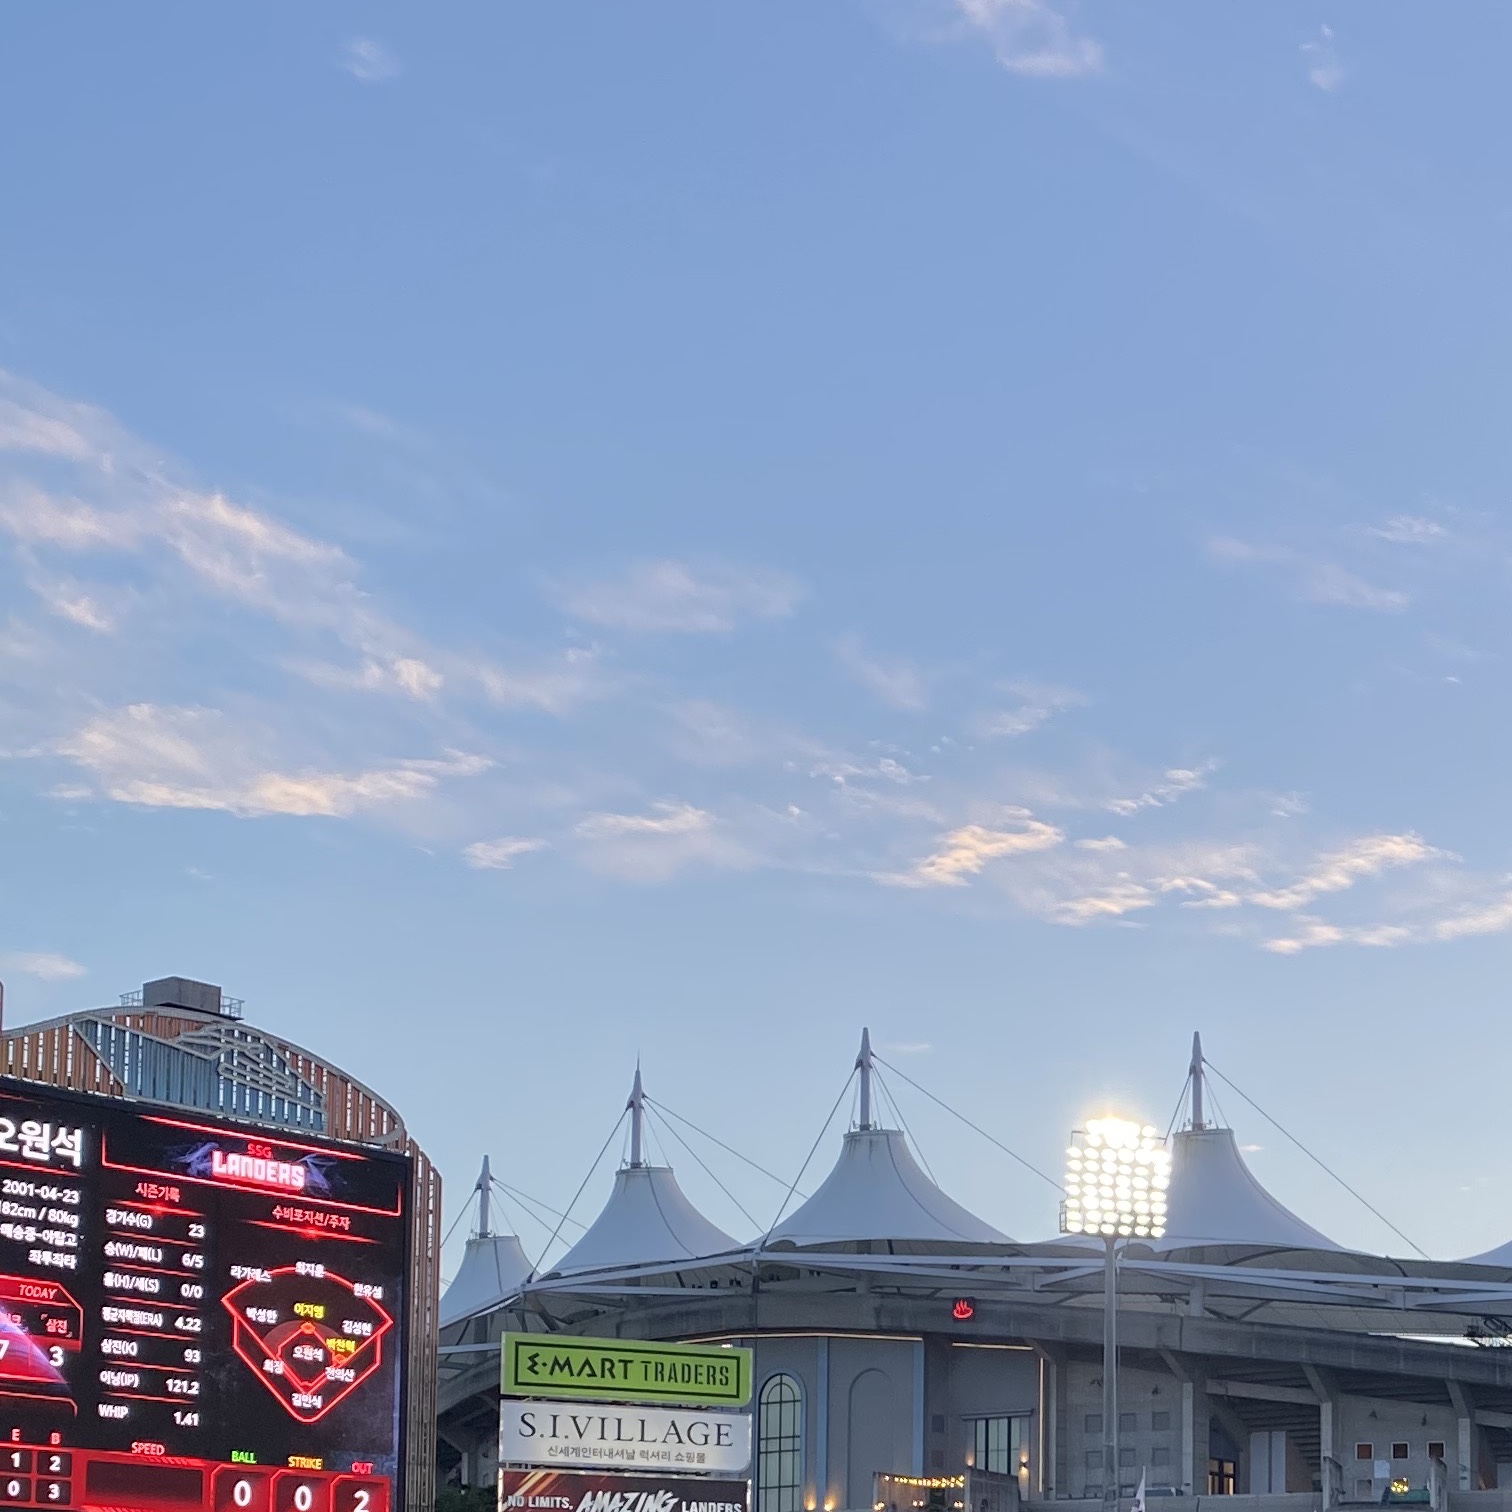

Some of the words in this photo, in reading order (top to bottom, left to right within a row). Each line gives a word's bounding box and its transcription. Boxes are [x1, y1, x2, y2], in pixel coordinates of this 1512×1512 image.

[0, 1117, 82, 1166] 오원석
[247, 1143, 272, 1158] SSG
[213, 1151, 305, 1187] LANDERS
[2, 1179, 79, 1204] 2001-04-23
[135, 1182, 180, 1203] 시즌기록
[48, 1209, 79, 1228] 80kg
[105, 1208, 153, 1229] 경기수(G)
[188, 1223, 205, 1238] 23
[272, 1205, 351, 1230] 수비포지션/주자
[28, 1250, 77, 1270] 좌투좌타
[182, 1253, 204, 1268] 6/5
[230, 1265, 271, 1282] 라가레스
[19, 1284, 57, 1300] TODAY
[180, 1283, 203, 1299] 0/0
[174, 1316, 201, 1331] 4.22
[49, 1345, 64, 1367] 3
[184, 1349, 200, 1363] 93
[100, 1370, 140, 1388] 이닝(IP)
[641, 1360, 729, 1386] TRADERS
[98, 1403, 128, 1419] WHIP
[173, 1411, 199, 1426] 1.41
[11, 1428, 20, 1441] E
[52, 1431, 61, 1445] B
[131, 1441, 165, 1456] SPEED
[231, 1451, 257, 1464] BALL
[547, 1446, 635, 1461] 신세계인터내셔날
[639, 1449, 671, 1462] 럭셔리
[674, 1451, 706, 1464] 쇼핑몰
[11, 1453, 20, 1468] 1
[50, 1456, 61, 1471] 2
[287, 1456, 323, 1470] STRIKE
[351, 1462, 374, 1474] OUT
[8, 1480, 20, 1496] 0
[49, 1483, 60, 1499] 3
[233, 1479, 252, 1507] 0
[294, 1485, 312, 1512] 0
[507, 1494, 525, 1507] NO
